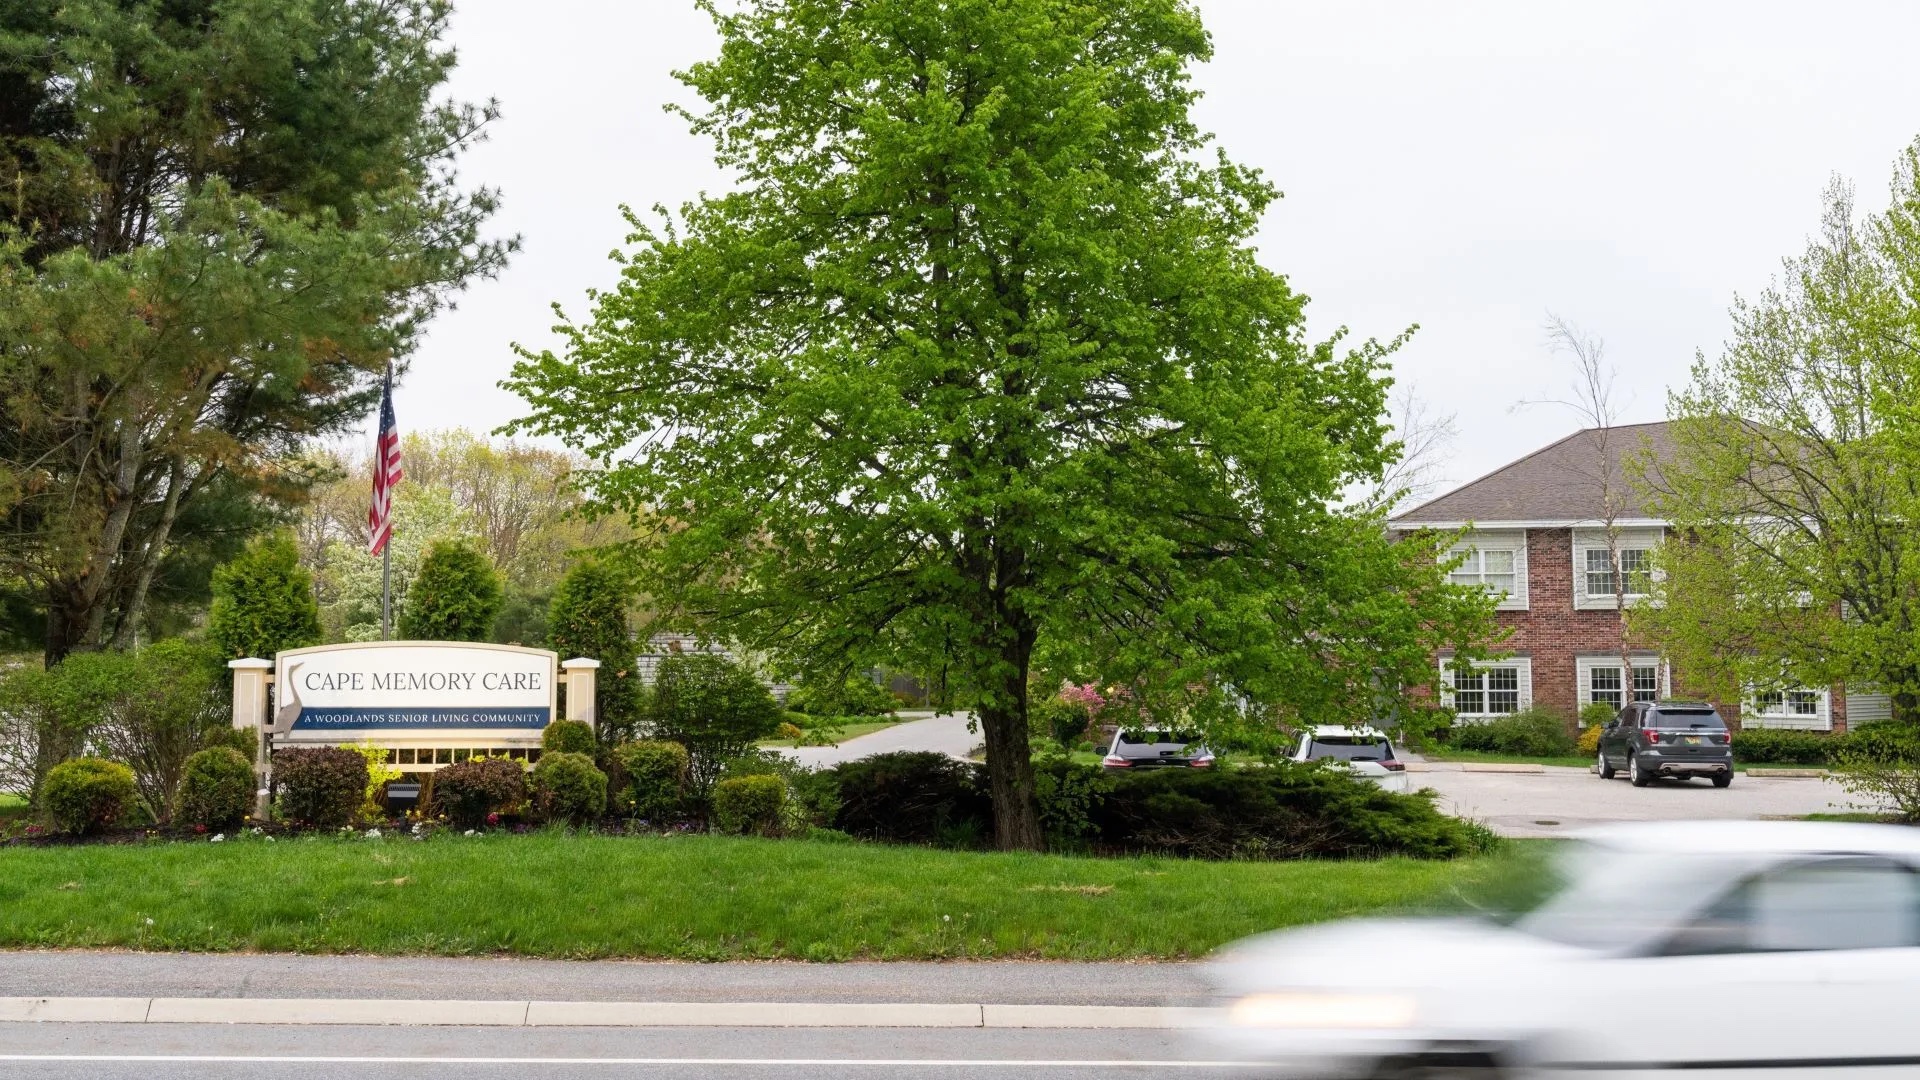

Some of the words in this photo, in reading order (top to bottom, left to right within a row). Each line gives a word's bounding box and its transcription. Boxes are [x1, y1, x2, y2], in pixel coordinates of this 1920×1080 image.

[305, 672, 363, 690] CAPE
[372, 672, 476, 690] MEMORY
[482, 672, 541, 690] CARE
[304, 714, 311, 723] A
[315, 714, 385, 723] WOODLANDS
[388, 714, 428, 723] SENIOR
[432, 713, 469, 723] LIVING
[472, 713, 540, 723] COMMUNITY
